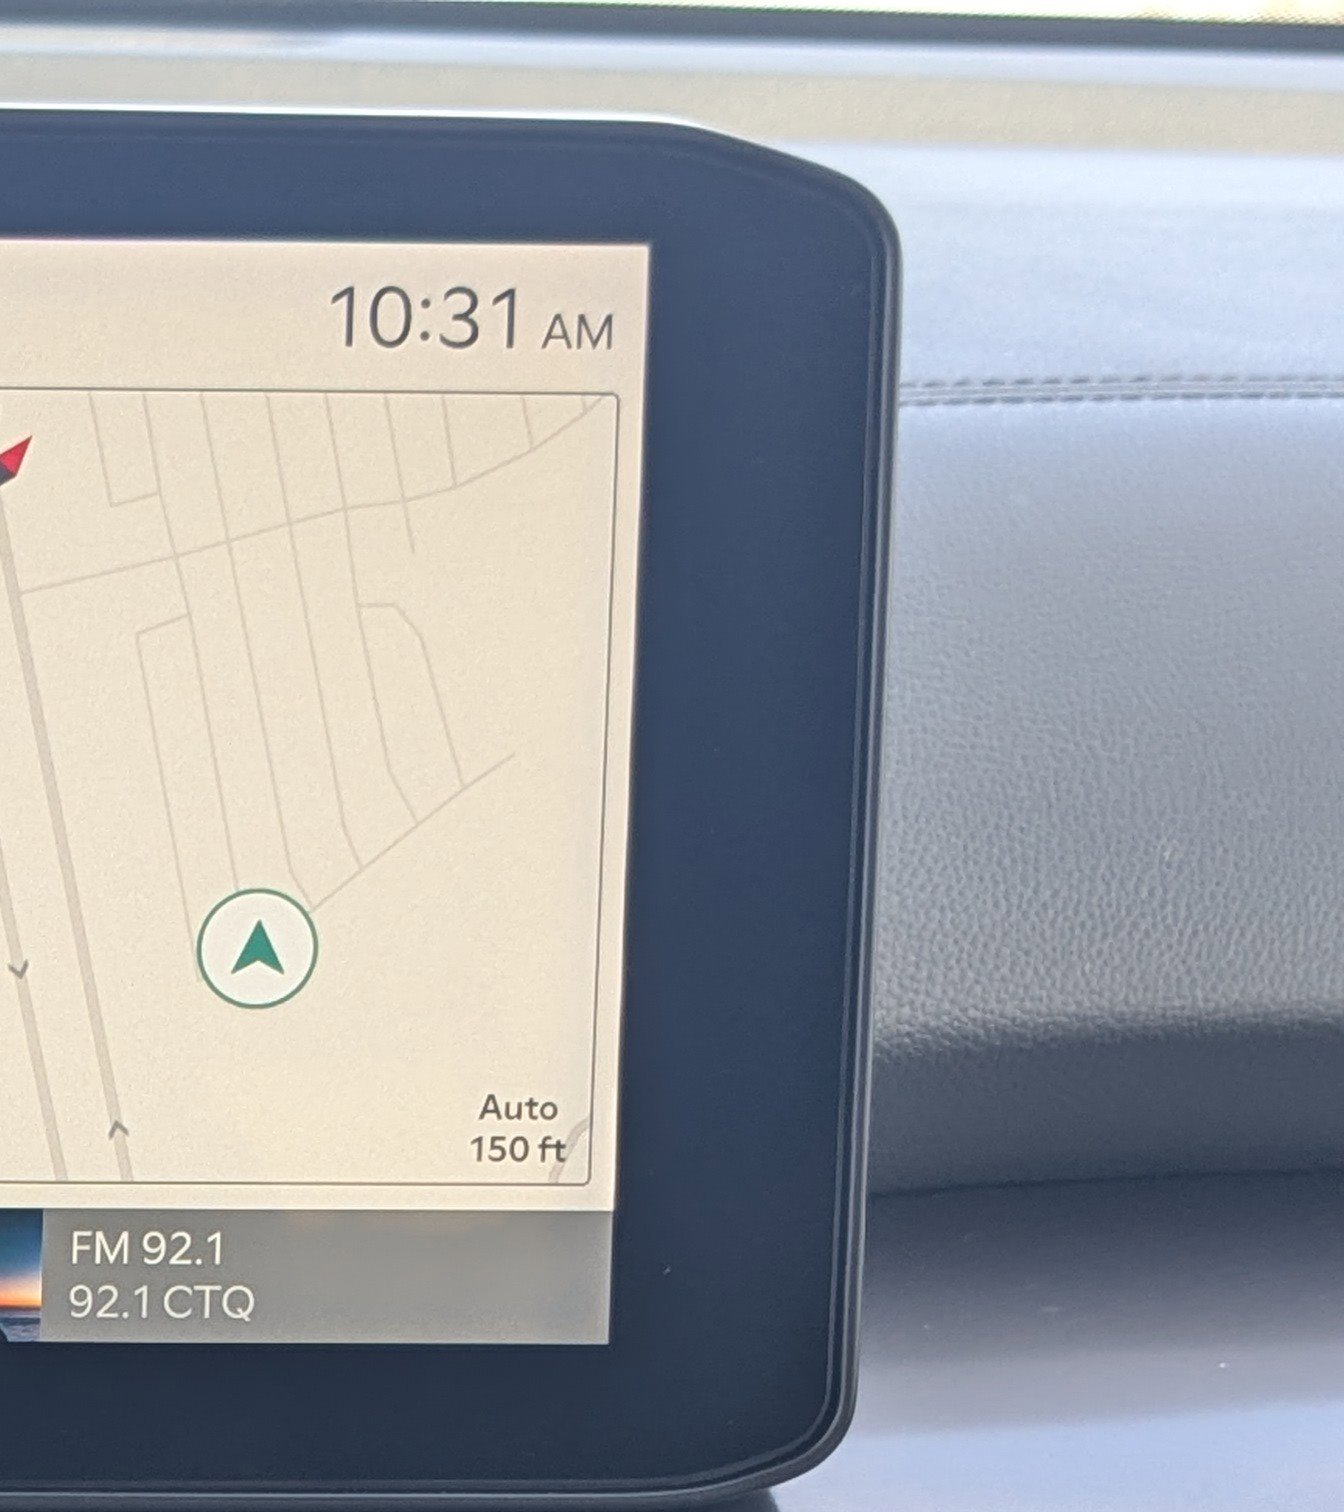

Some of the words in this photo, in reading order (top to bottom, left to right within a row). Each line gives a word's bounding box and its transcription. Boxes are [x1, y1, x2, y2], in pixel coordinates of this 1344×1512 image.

[329, 284, 518, 351] 10:31
[540, 312, 614, 350] AM
[478, 1094, 559, 1123] Auto
[470, 1136, 530, 1163] 150
[537, 1135, 567, 1164] ft
[70, 1231, 130, 1265] FM
[141, 1232, 224, 1266] 92.1
[69, 1286, 150, 1319] 92.1
[163, 1286, 256, 1323] CTQ
